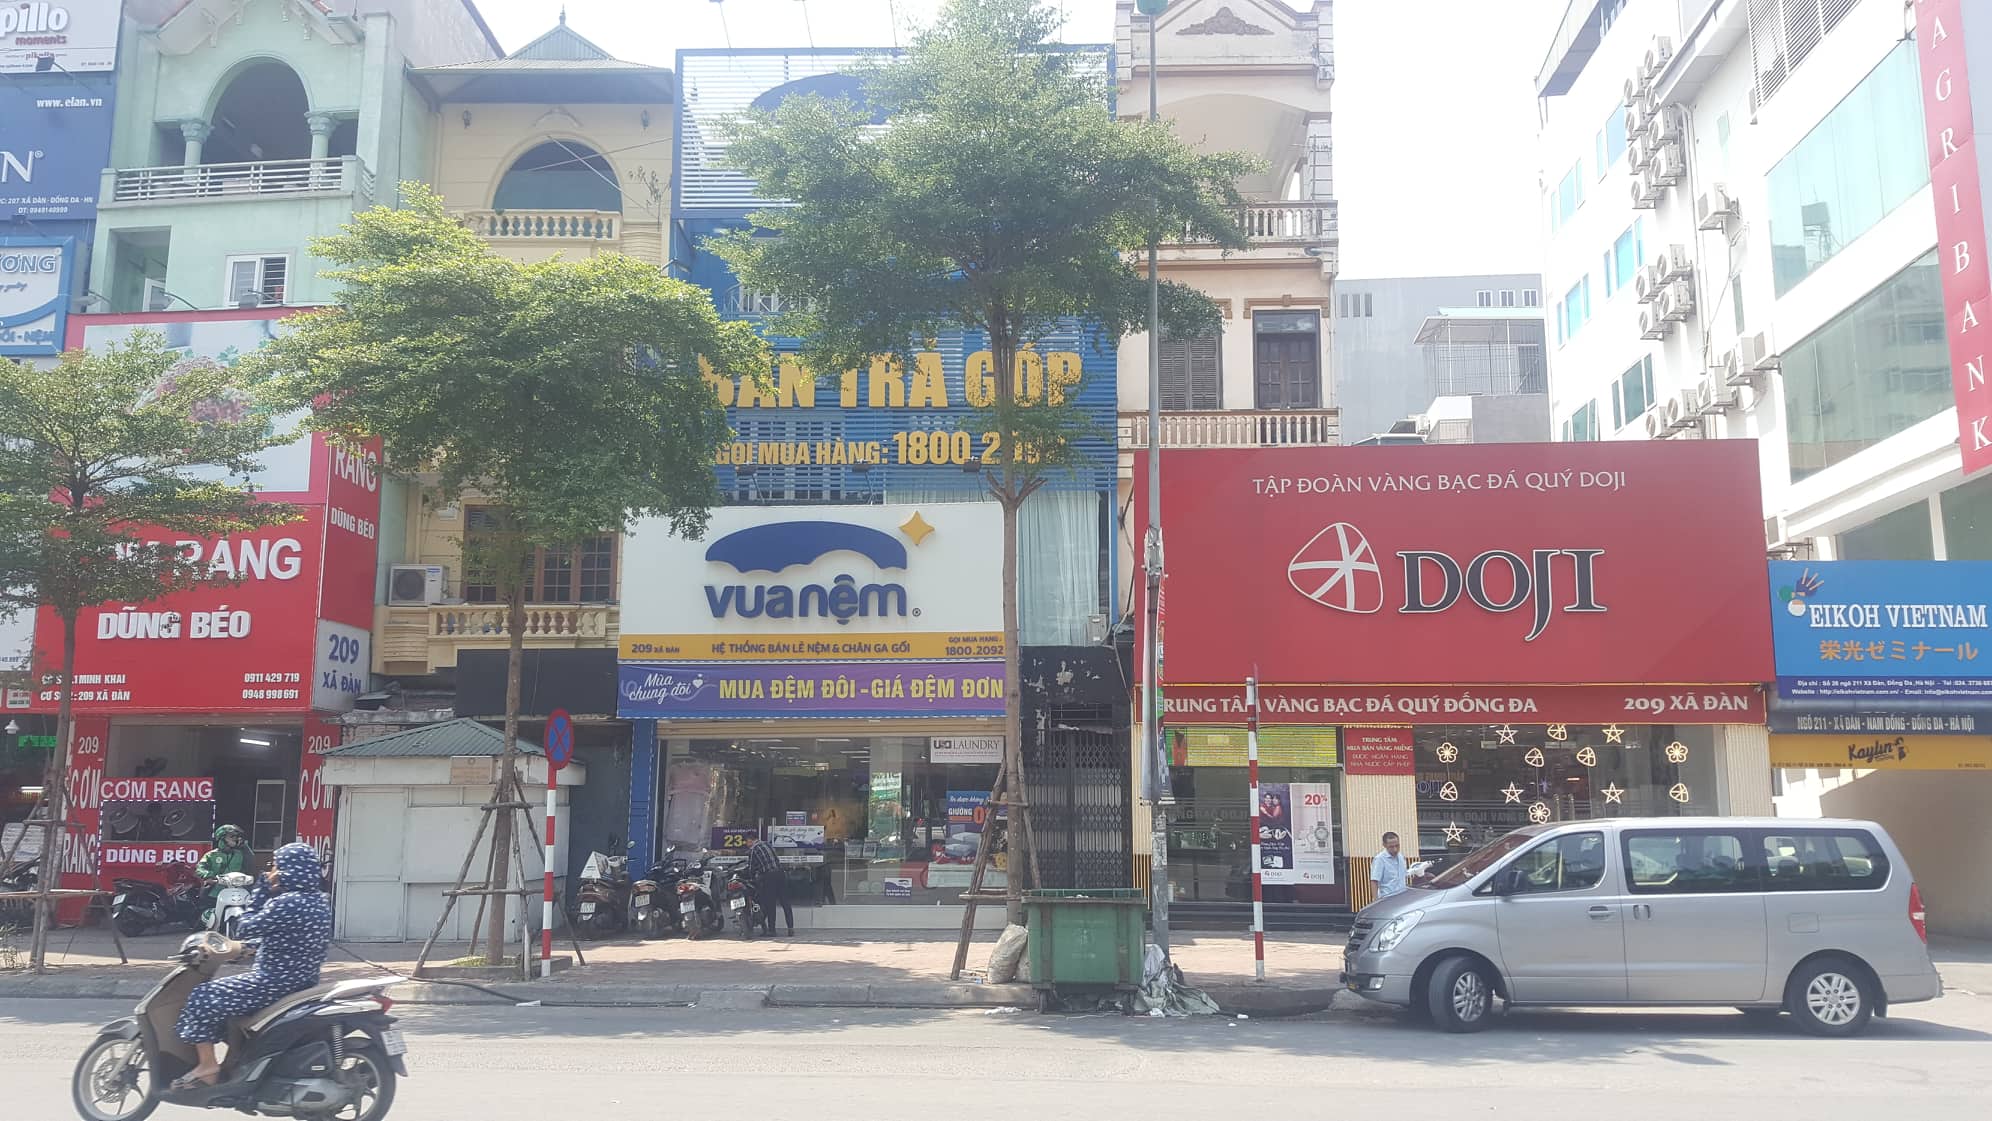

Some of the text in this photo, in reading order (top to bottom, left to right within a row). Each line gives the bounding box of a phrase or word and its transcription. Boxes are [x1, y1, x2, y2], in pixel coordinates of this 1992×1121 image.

[15, 35, 67, 46] moments
[0, 253, 56, 274] ƠNG
[757, 442, 811, 465] MUA
[1253, 468, 1626, 498] TẬP ĐOÀN VÀNG BẠC ĐÁ QUÝ DOJI
[330, 507, 375, 540] DŨNG BÉO
[1396, 549, 1608, 642] DOJI
[97, 604, 251, 640] DŨNG BÉO
[1808, 603, 1989, 629] EIKOH VIETNAM
[328, 633, 360, 664] 209
[632, 643, 653, 654] 209
[711, 643, 726, 656] HỆ
[729, 640, 764, 655] THỐNG
[767, 642, 790, 654] BÁN
[792, 641, 806, 654] LẺ
[807, 641, 830, 656] NỆM
[831, 644, 840, 653] &
[873, 643, 889, 654] GA
[891, 640, 910, 654] GỐI
[1819, 639, 1979, 661] 栄光ゼミナール
[79, 674, 101, 684] MINH
[104, 674, 126, 684] KHAI
[244, 673, 300, 683] 0911 429 719
[644, 672, 673, 688] Mùa
[96, 689, 109, 701] XÃ
[111, 690, 131, 701] ĐÀN
[628, 679, 692, 705] chung đôi
[719, 679, 765, 699] MUA
[769, 674, 815, 703] ĐỆM
[821, 674, 856, 699] ĐÔI
[909, 674, 955, 703] ĐỆM
[960, 676, 1004, 699] ĐƠN
[1162, 698, 1217, 714] RUNG
[1264, 695, 1323, 713] VÀNG
[1323, 697, 1362, 716] BẠC
[1365, 694, 1395, 713] ĐÁ
[1397, 695, 1440, 716] QUÝ
[1444, 691, 1504, 713] ĐỐNG
[1508, 698, 1537, 713] ĐA
[1624, 692, 1748, 715] 209 XÃ ĐÀN
[1814, 717, 1828, 731] 211
[1866, 716, 1885, 731] NAM
[1933, 717, 1944, 731] ĐA
[1949, 715, 1960, 731] HÀ
[77, 736, 99, 754] 209
[308, 735, 331, 754] 209
[953, 739, 1000, 750] LAUNDRY
[100, 780, 213, 799] CƠM RANG
[105, 847, 199, 864] DŨNG BÉO
